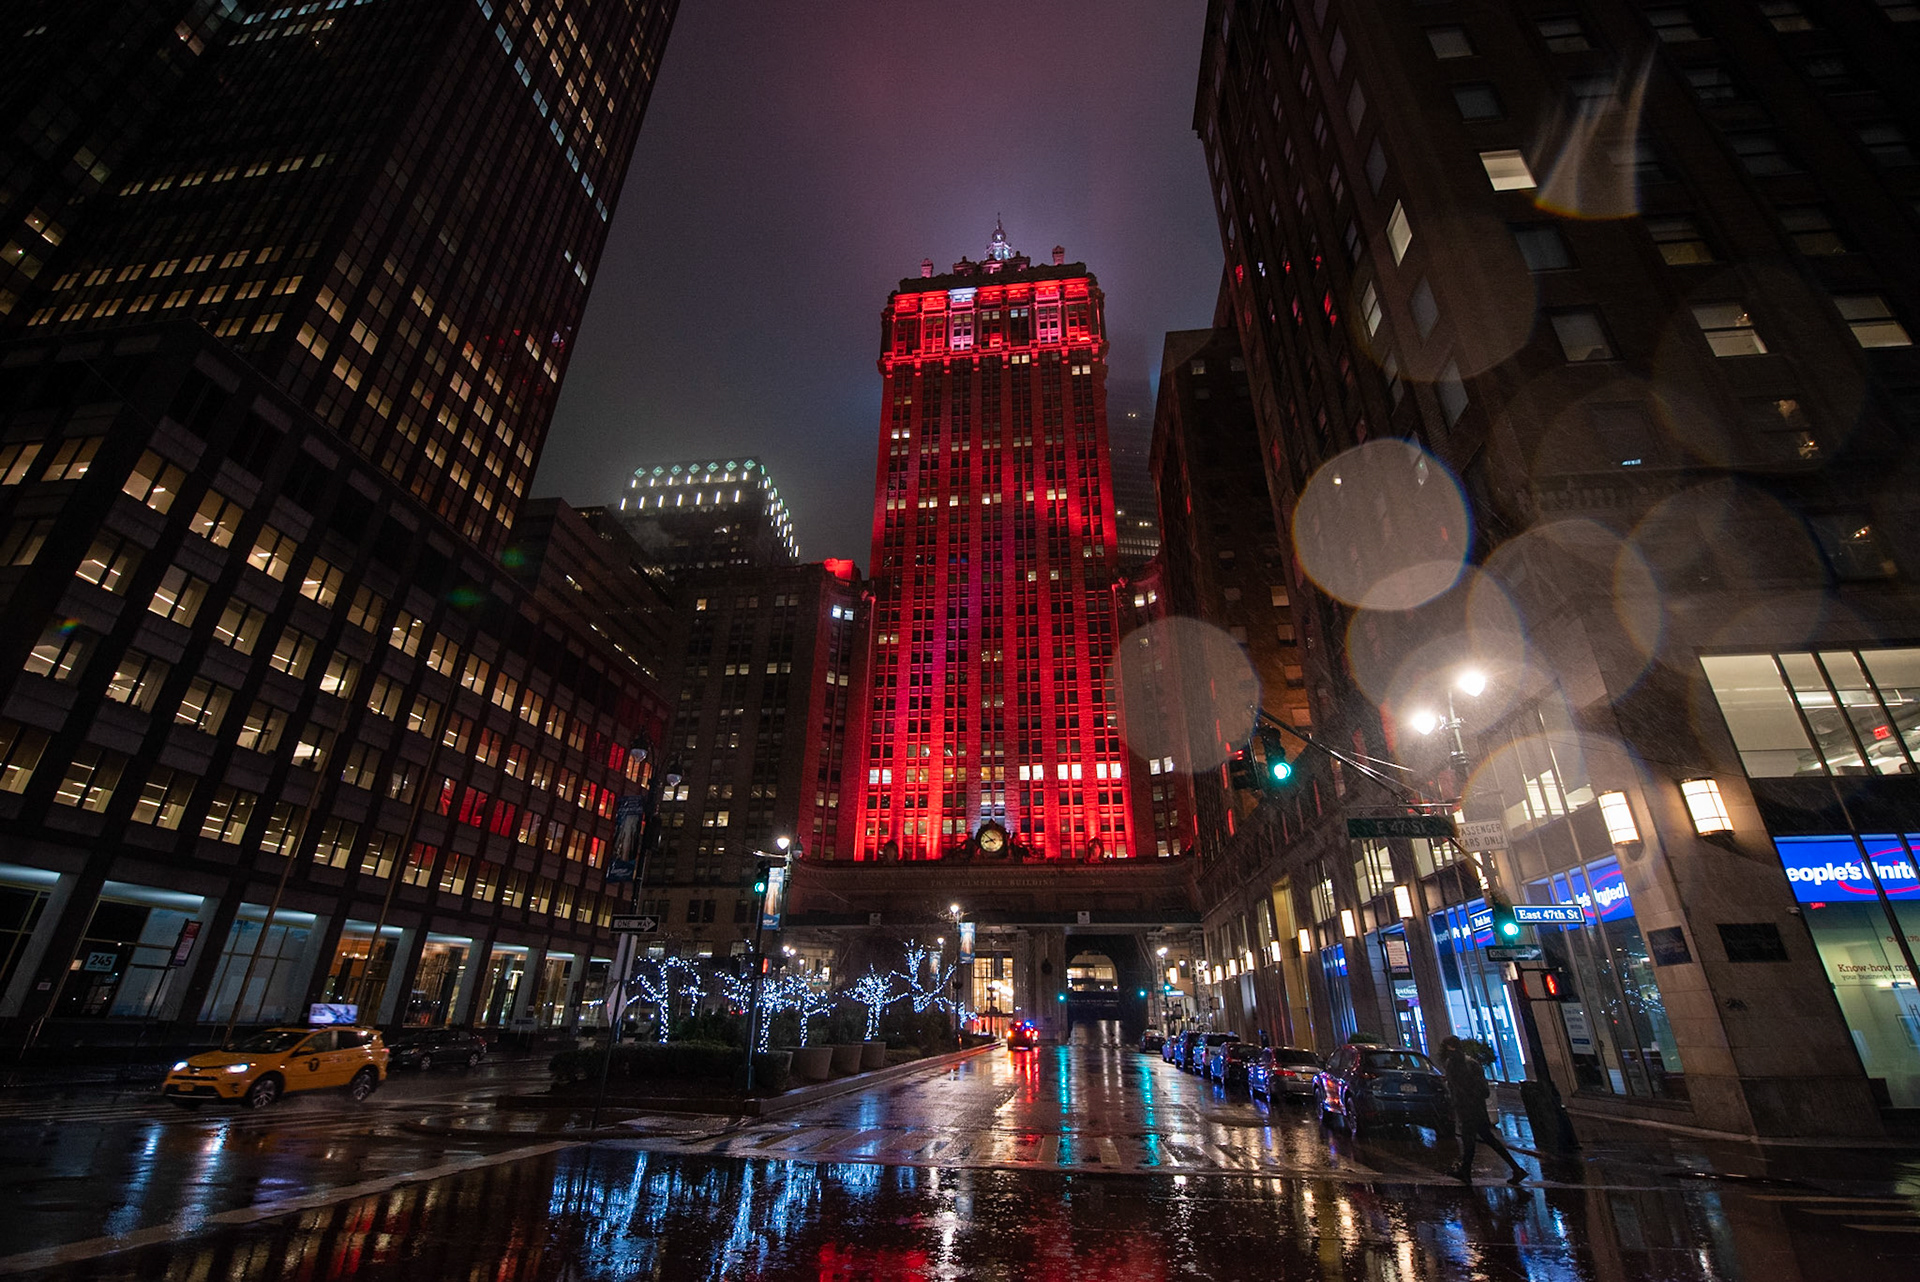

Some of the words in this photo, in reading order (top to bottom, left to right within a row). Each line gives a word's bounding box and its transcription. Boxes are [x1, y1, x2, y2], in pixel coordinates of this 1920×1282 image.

[1377, 821, 1387, 834] E
[1391, 820, 1406, 834] 47
[1459, 837, 1480, 848] CARS
[1484, 835, 1504, 846] ONLY
[1786, 862, 1862, 885] eople's
[1009, 879, 1055, 887] BUILDING
[1518, 909, 1541, 920] East
[1543, 909, 1565, 920] 47th
[1566, 909, 1579, 920] St
[90, 955, 112, 966] 245
[1837, 964, 1890, 973] Know-how
